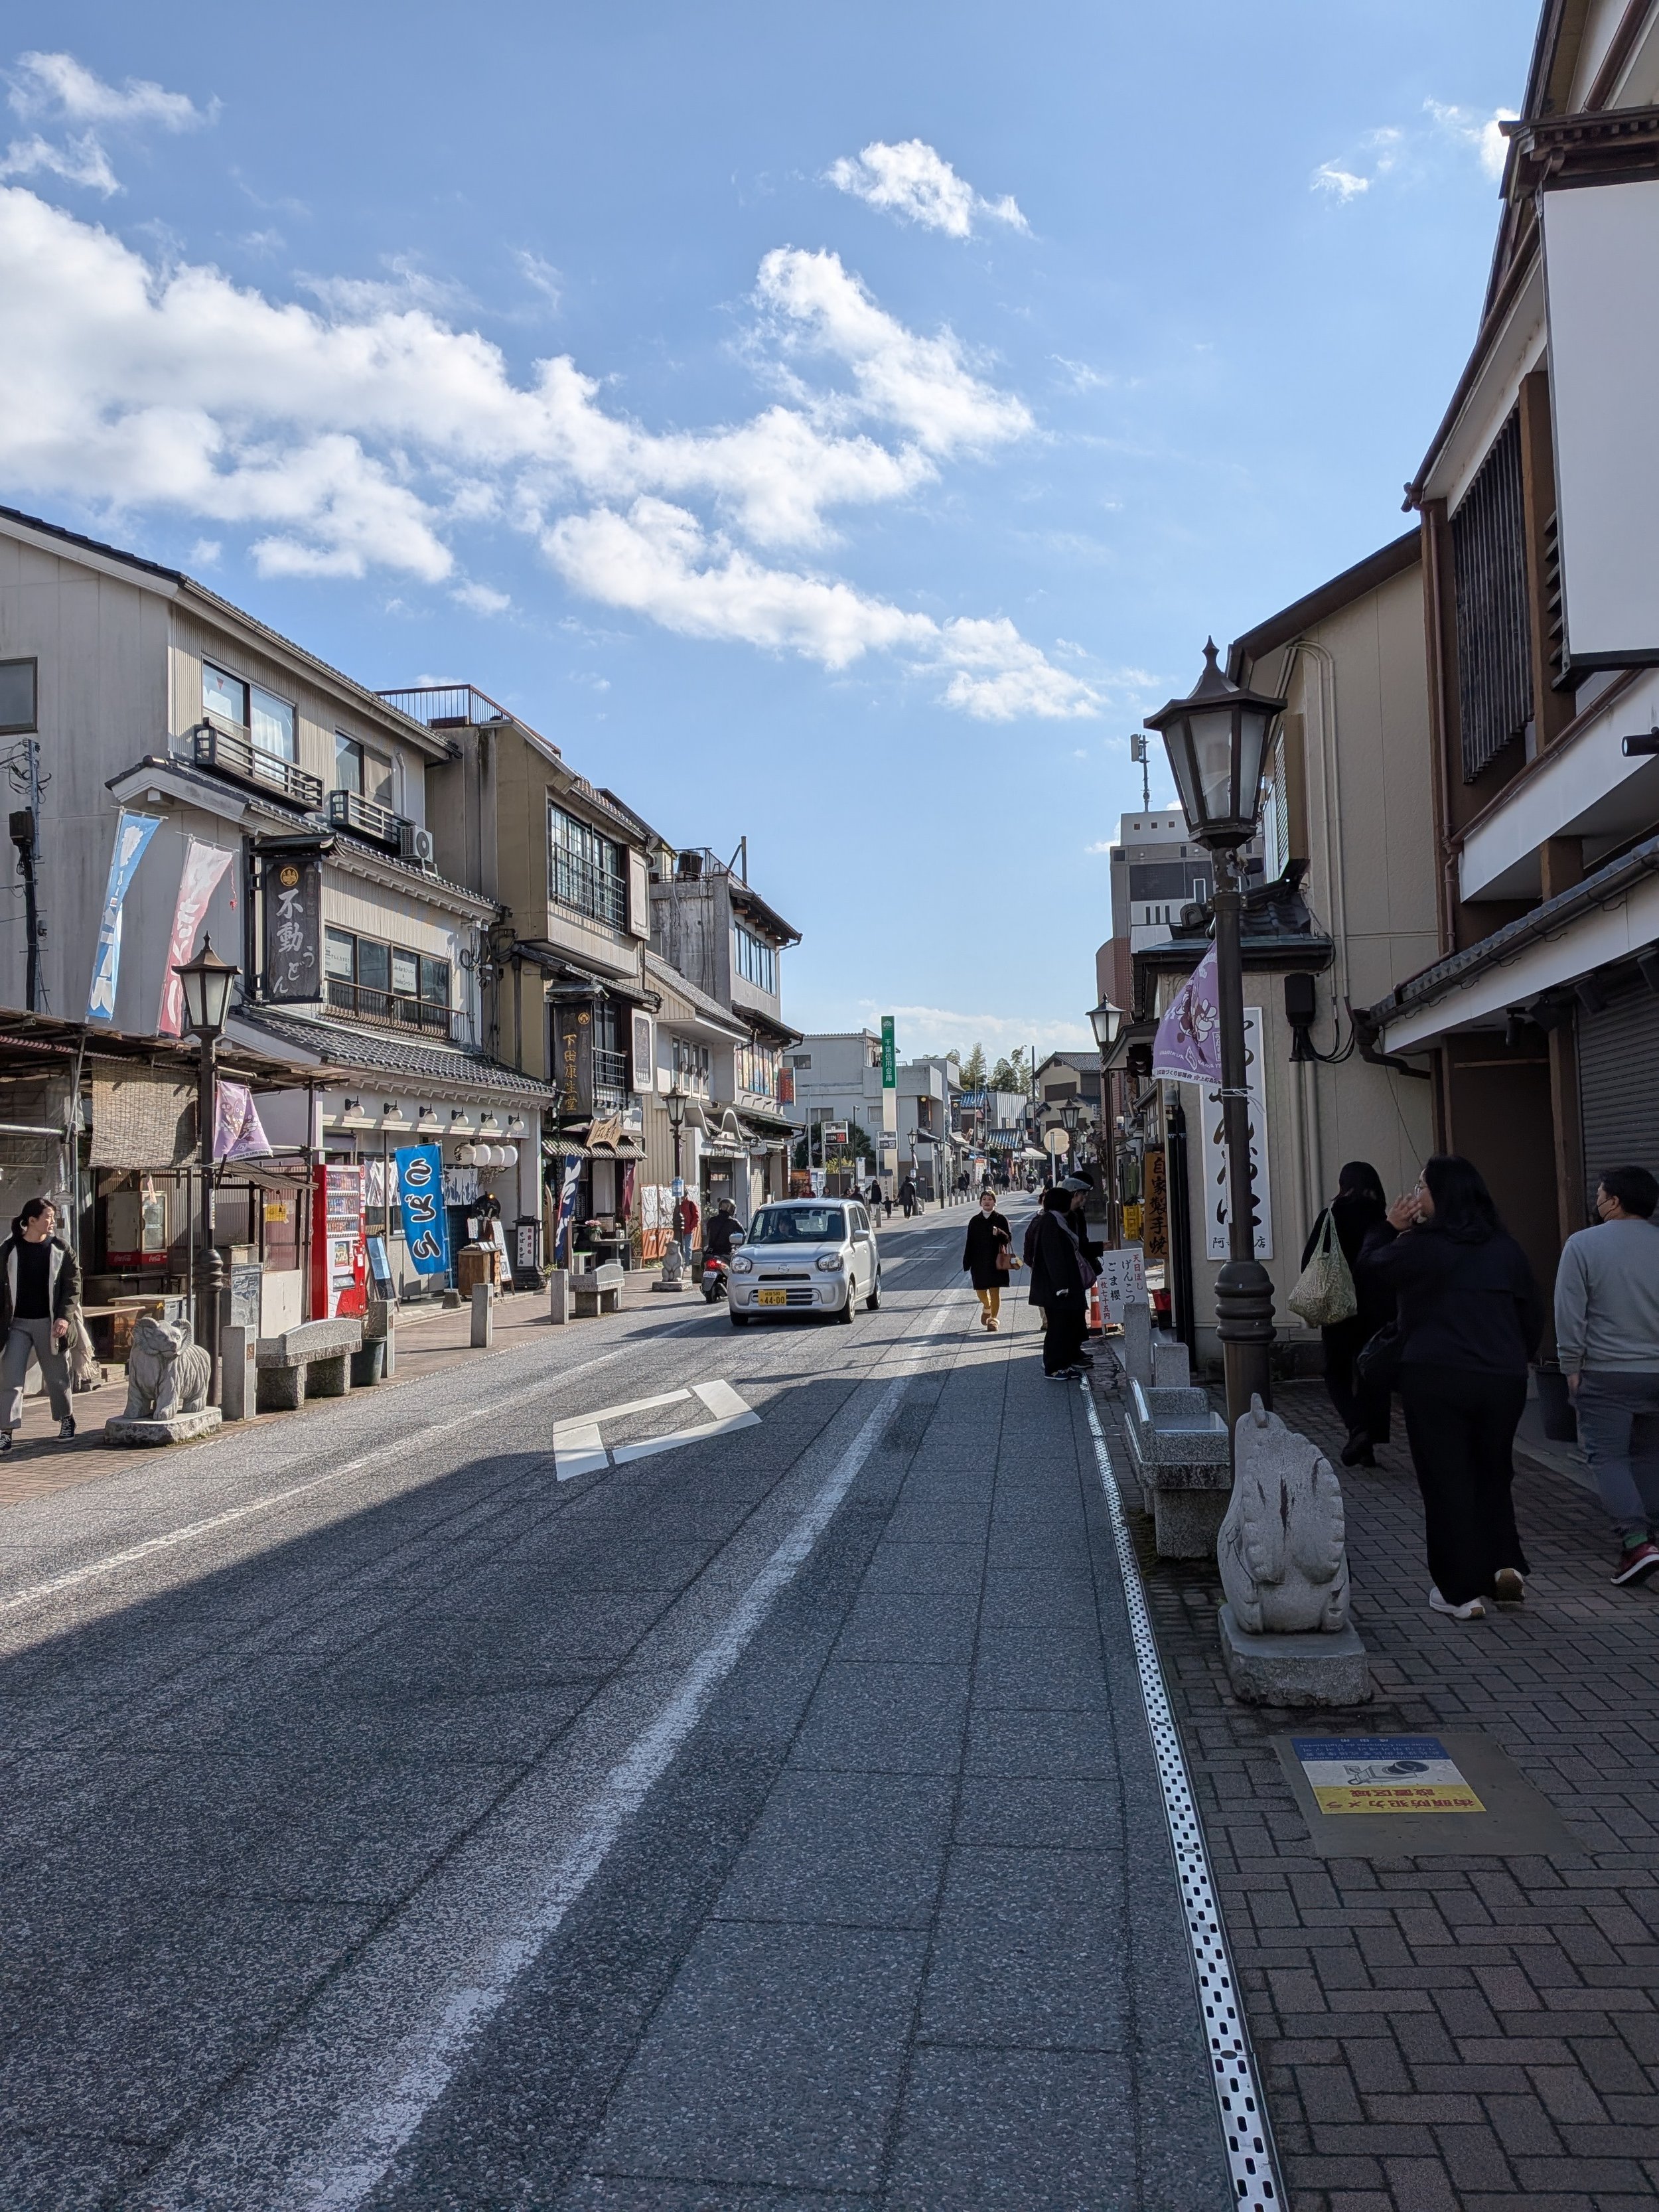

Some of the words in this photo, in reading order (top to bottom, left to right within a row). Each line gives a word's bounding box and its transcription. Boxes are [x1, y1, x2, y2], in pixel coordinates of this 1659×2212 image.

[275, 887, 304, 953] 不動
[273, 945, 315, 994] うどん
[562, 1033, 578, 1112] 下田康生堂
[1149, 1157, 1168, 1255] 自家製手焼
[1100, 1278, 1111, 1320] 一枚七十五円
[1121, 1259, 1135, 1303] げんこつ
[1325, 1799, 1476, 1808] 街頭防犯カメラ
[1351, 1788, 1436, 1797] 設置区域
